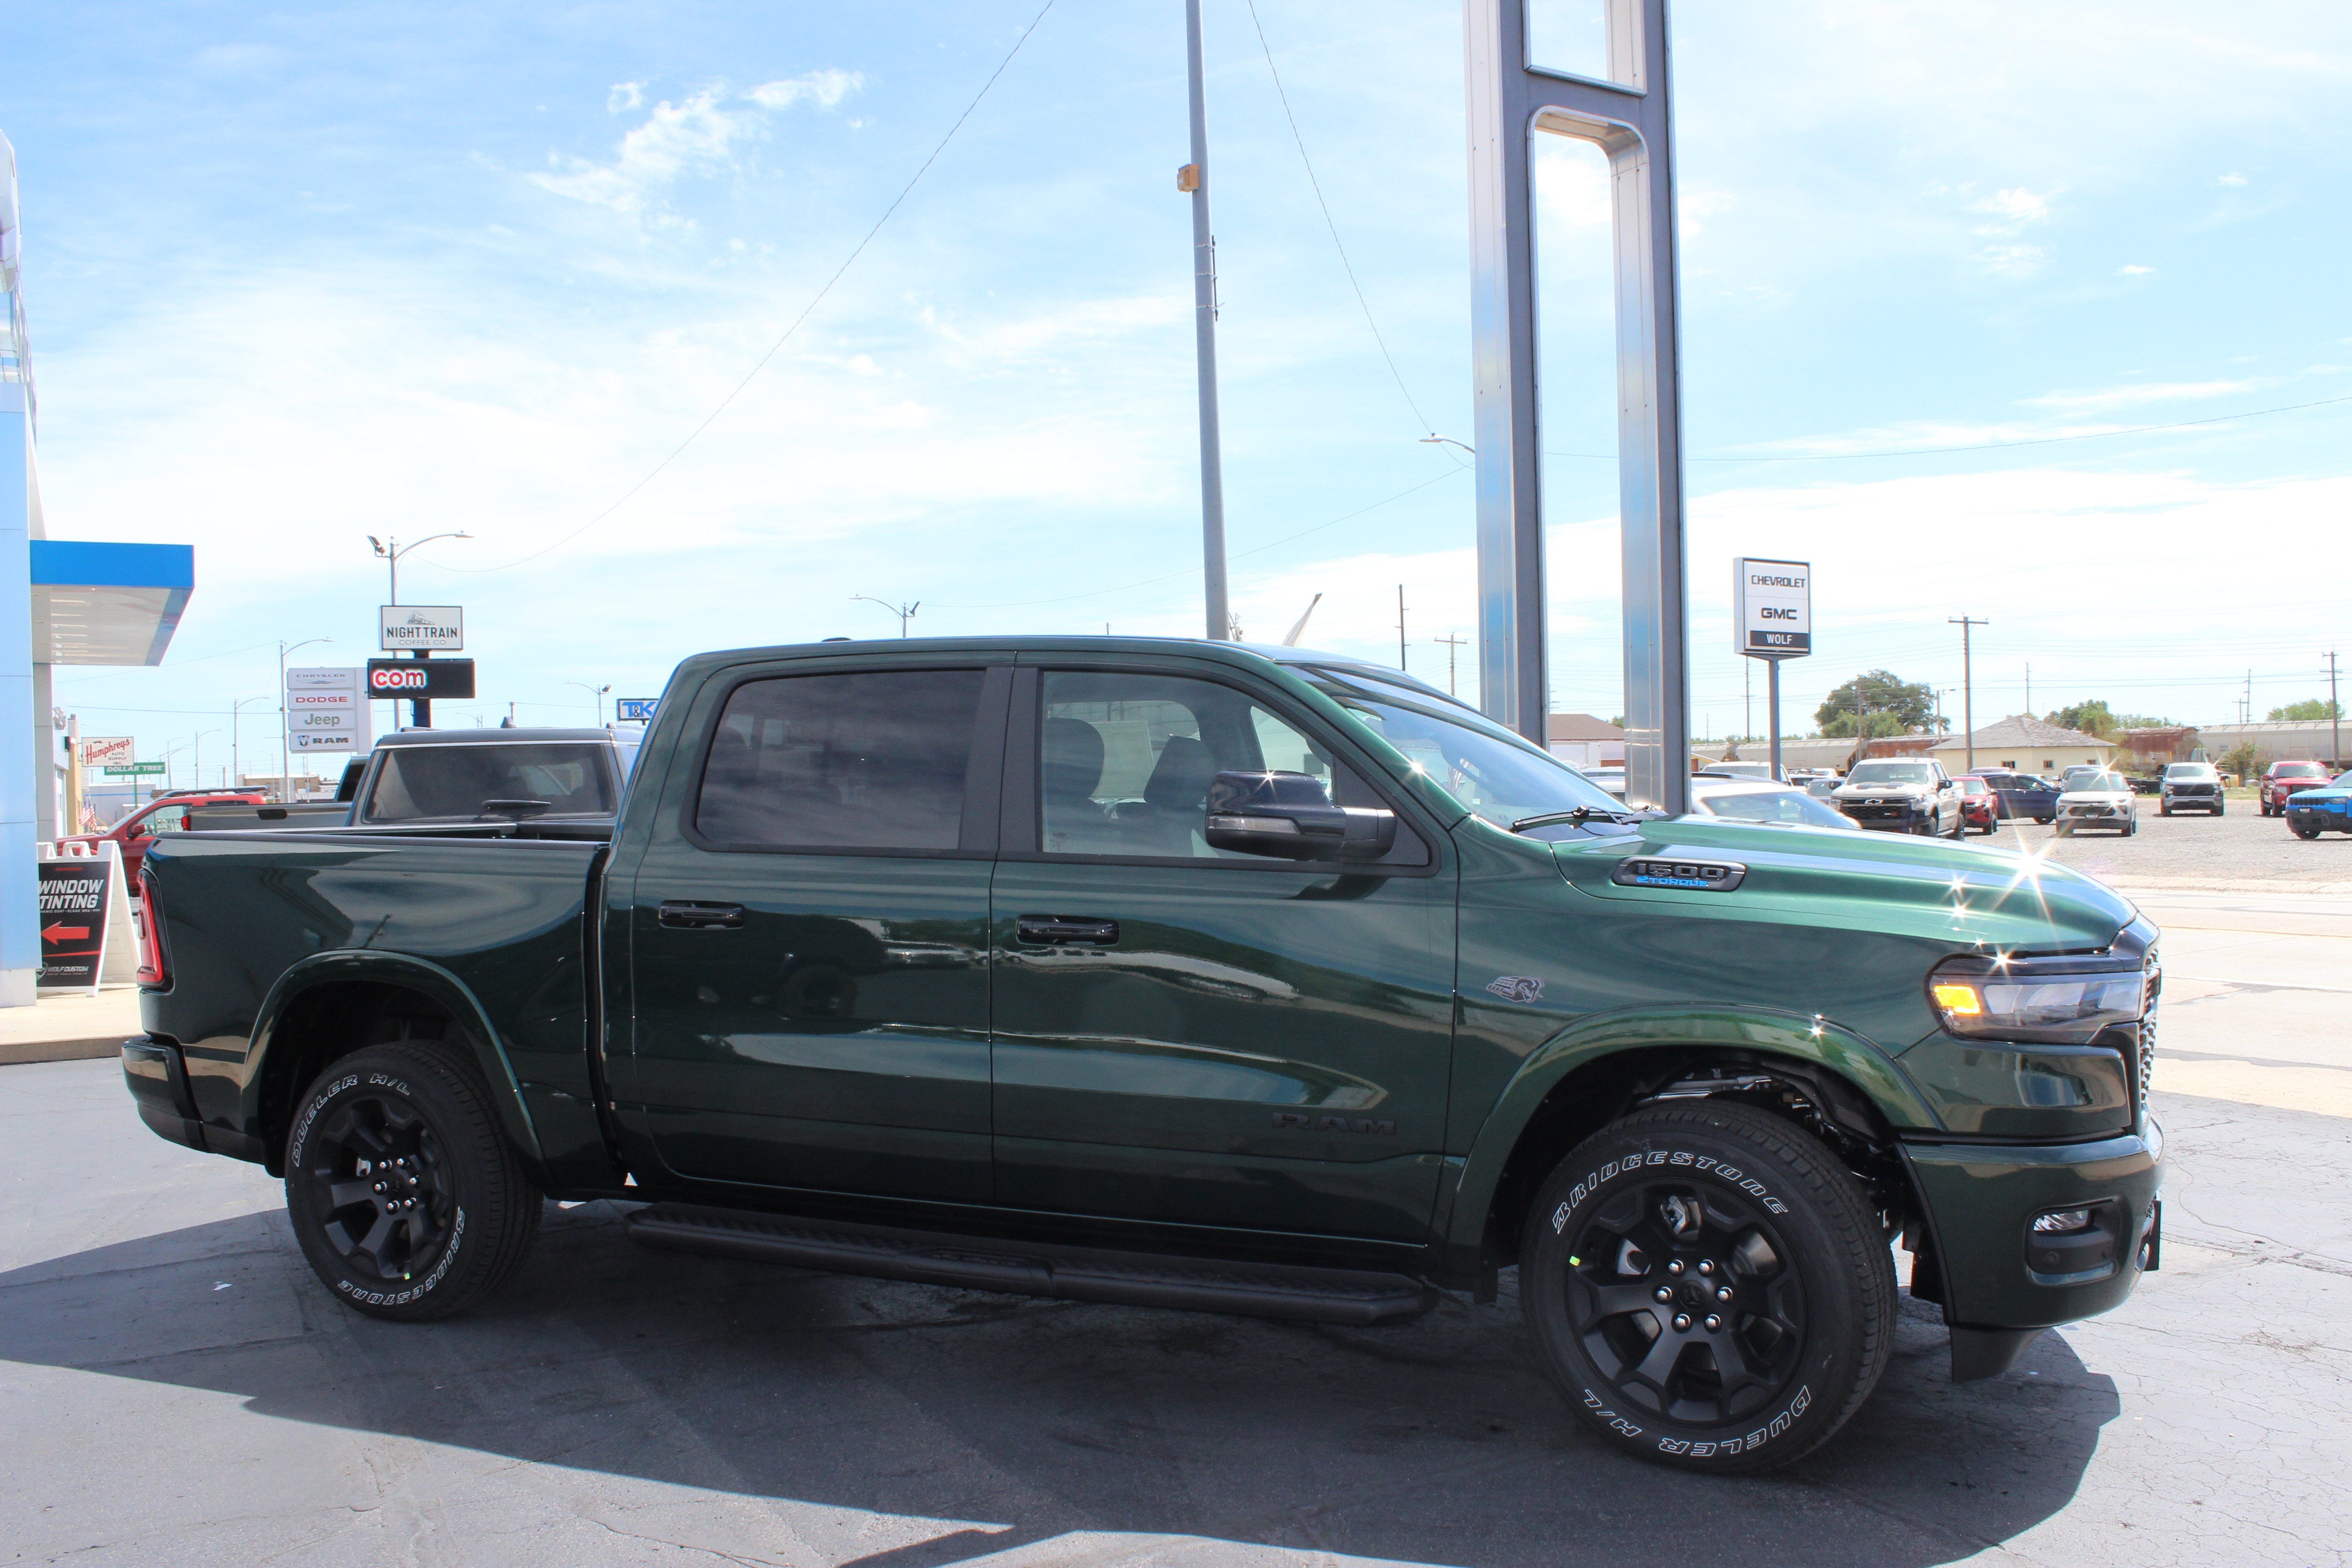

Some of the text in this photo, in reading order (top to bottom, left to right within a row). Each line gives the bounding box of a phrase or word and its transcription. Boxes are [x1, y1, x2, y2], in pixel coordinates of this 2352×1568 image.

[1751, 574, 1806, 588] CHEVROLET
[1761, 607, 1798, 620] GMC
[1766, 633, 1793, 645] WOLF
[304, 713, 341, 727] Jeep
[86, 738, 130, 765] Humphreys
[1637, 863, 1725, 880] 1500
[38, 879, 104, 895] WINDOW
[40, 895, 98, 909] TINTING
[291, 1073, 410, 1167] DUELER H/L
[1272, 1112, 1396, 1135] RAM
[1552, 1151, 1788, 1235] BRIDGESTONE
[337, 1206, 466, 1306] BRIDGESTONE
[1583, 1385, 1812, 1457] DUELER H/L
